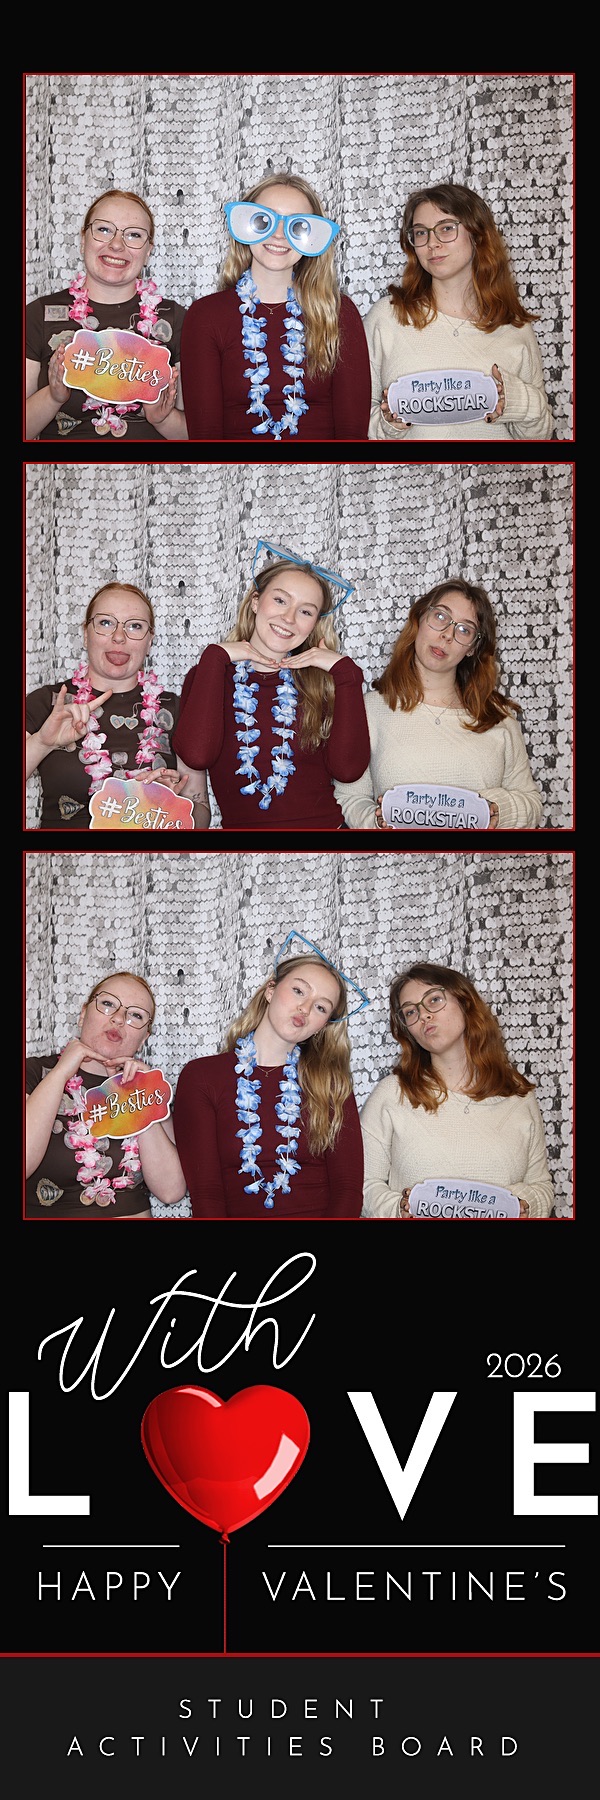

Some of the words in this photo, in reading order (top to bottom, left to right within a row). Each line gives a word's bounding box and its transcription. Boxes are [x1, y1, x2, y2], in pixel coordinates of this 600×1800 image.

[71, 348, 163, 387] #Besties
[411, 380, 442, 394] Party
[443, 378, 462, 391] like
[464, 380, 471, 390] a
[397, 393, 489, 414] ROCKSTAR
[406, 791, 437, 808] Party
[438, 793, 457, 807] like
[458, 799, 465, 808] a
[390, 806, 479, 829] ROCKSTAR
[89, 1088, 166, 1122] #Besties
[435, 1185, 468, 1203] Party
[468, 1189, 488, 1203] like
[488, 1195, 496, 1205] a
